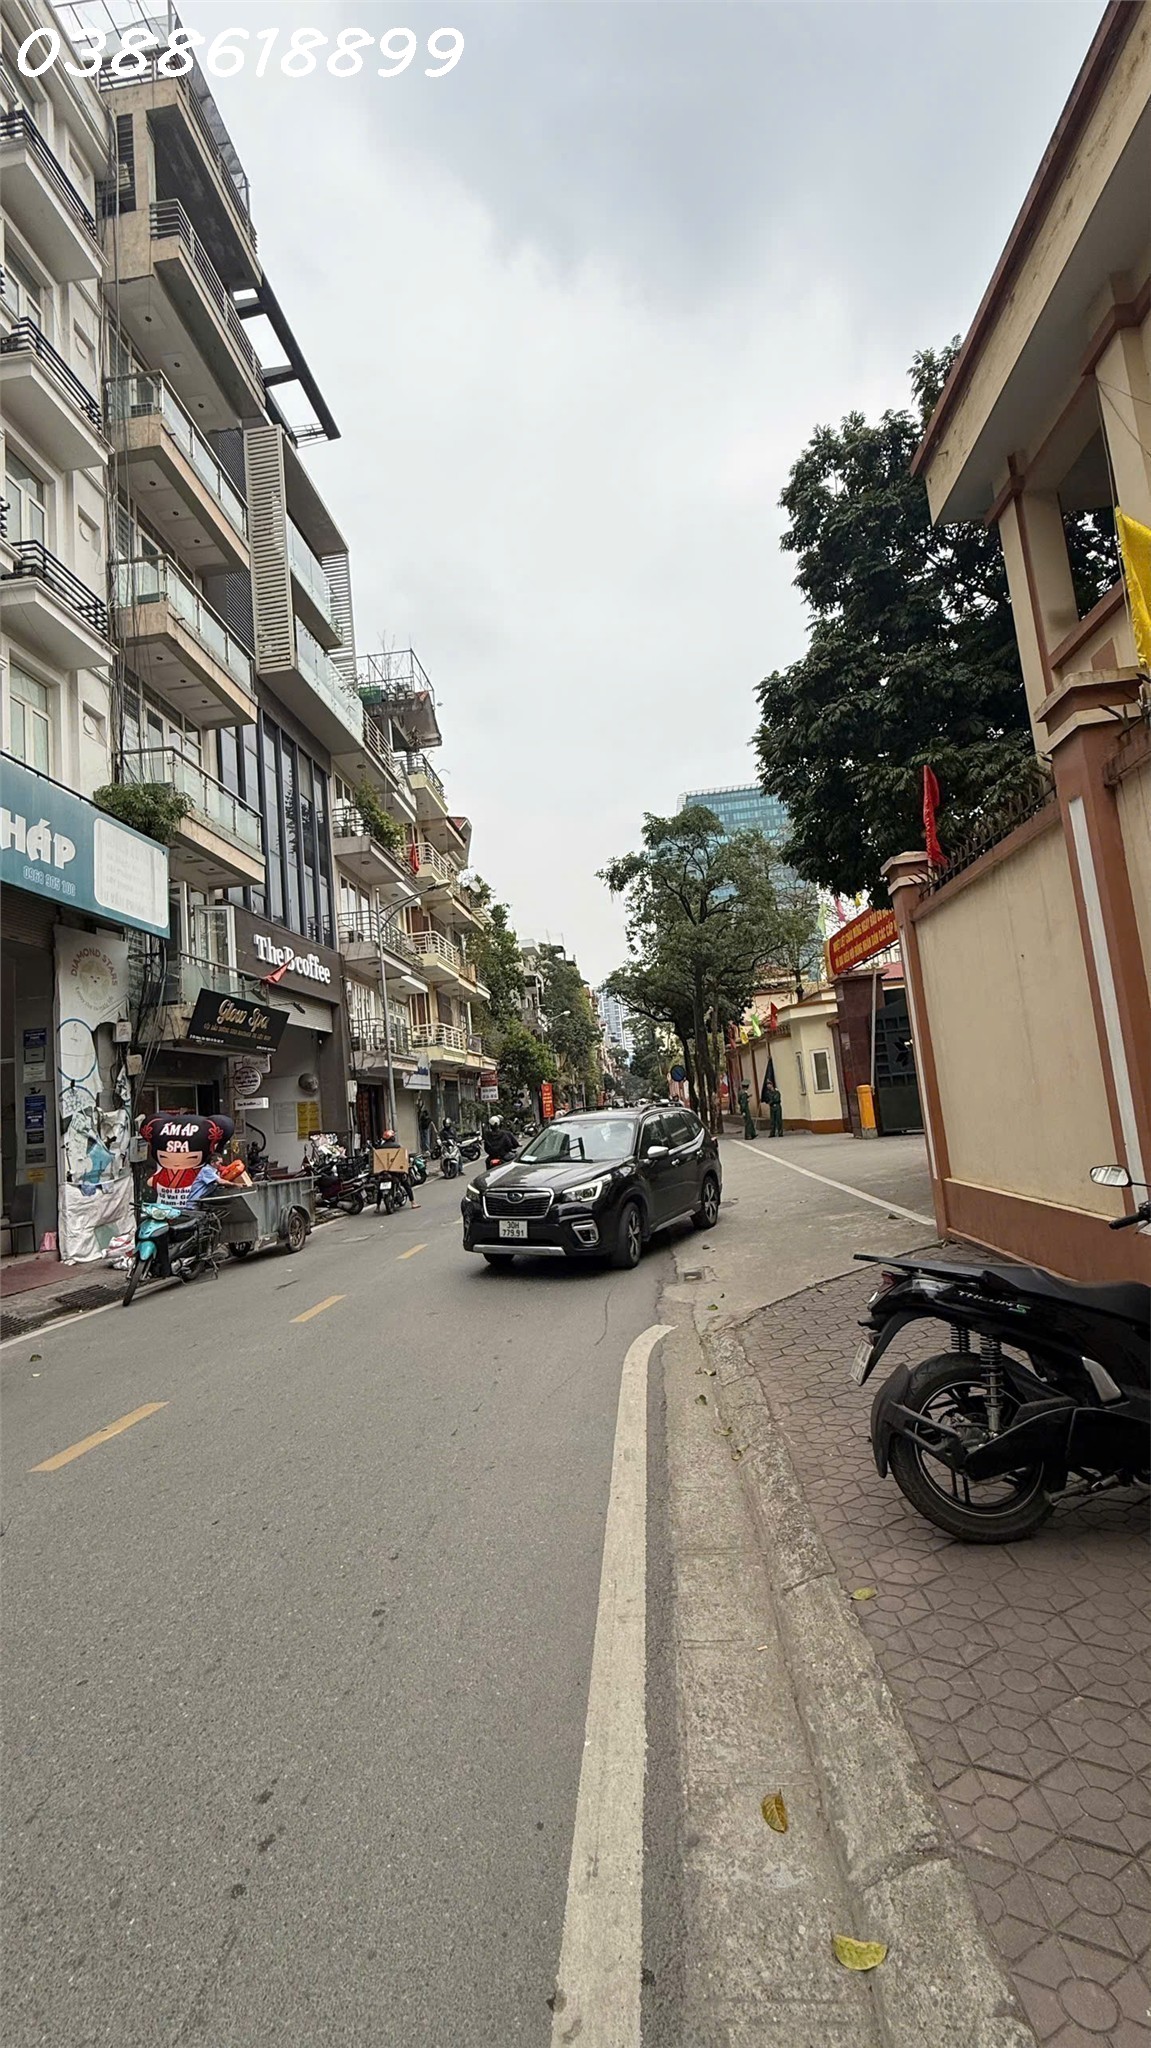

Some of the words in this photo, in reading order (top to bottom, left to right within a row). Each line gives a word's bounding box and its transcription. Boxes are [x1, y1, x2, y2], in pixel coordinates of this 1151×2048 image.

[71, 947, 101, 977] DIAMOND
[102, 954, 118, 986] STARS
[248, 1007, 270, 1032] Spa
[166, 1140, 190, 1153] SPA
[507, 1220, 520, 1229] 30H
